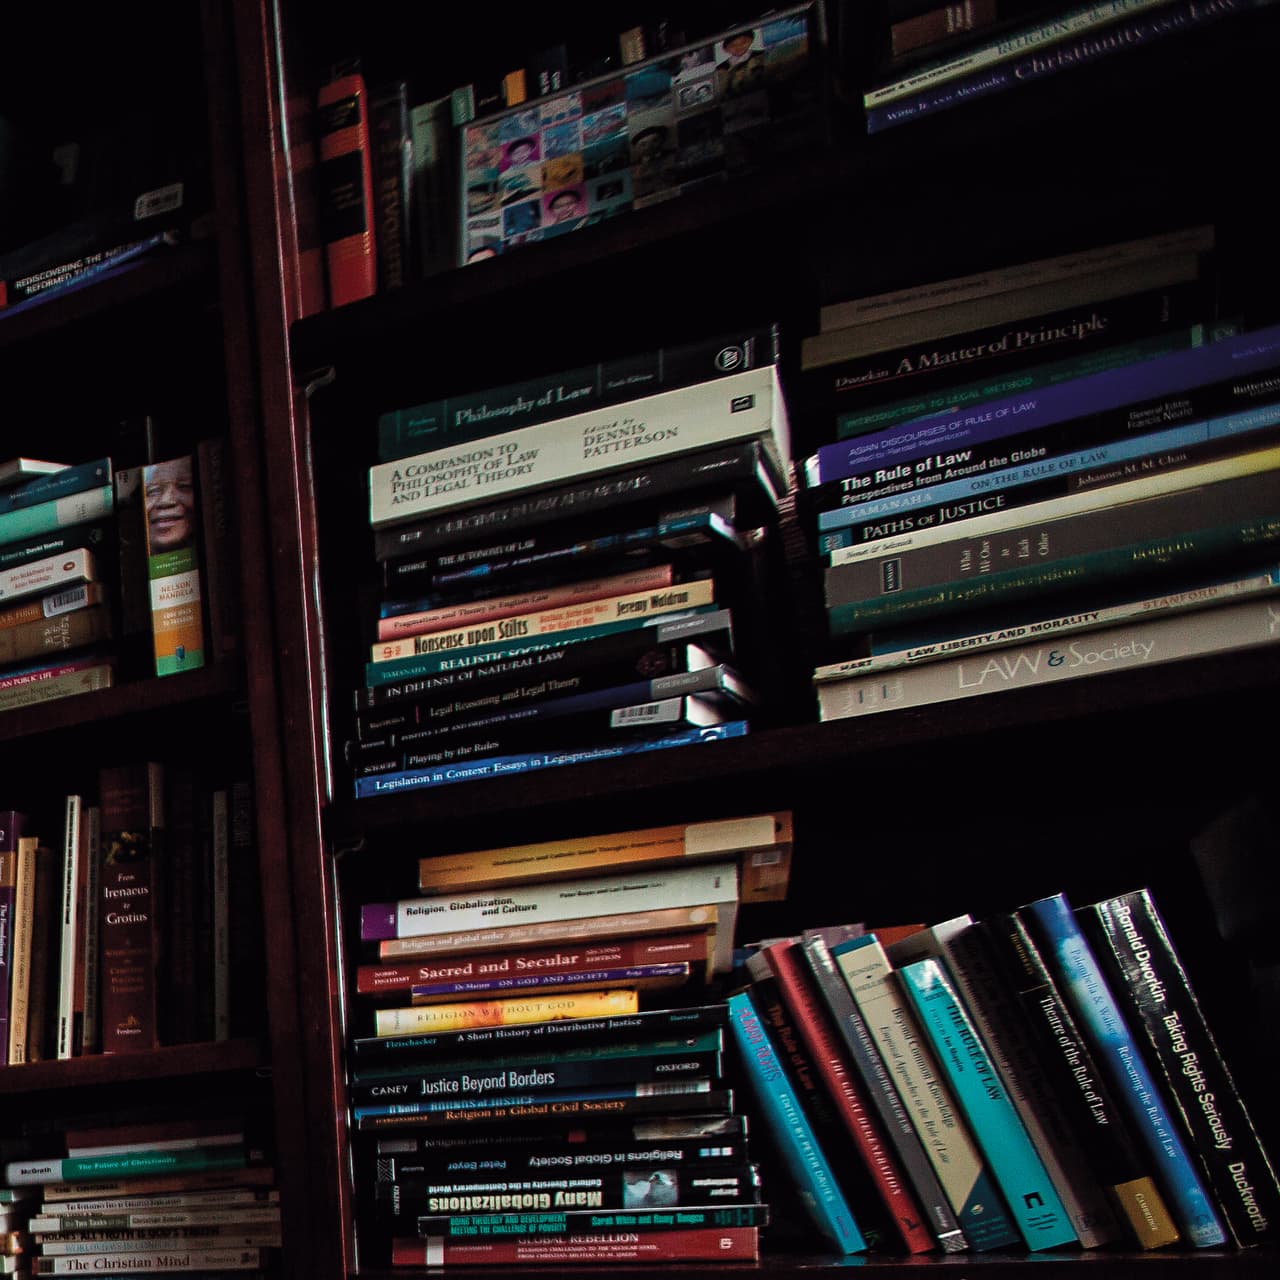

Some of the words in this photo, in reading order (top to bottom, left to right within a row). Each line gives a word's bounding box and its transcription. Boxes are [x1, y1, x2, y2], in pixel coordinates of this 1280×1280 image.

[896, 358, 913, 375] A
[918, 345, 986, 371] Matter
[989, 333, 1012, 353] of
[1016, 314, 1109, 348] Principle
[455, 396, 533, 426] Philosophy
[534, 391, 552, 408] of
[555, 384, 592, 401] Law
[583, 424, 645, 446] DENNIS
[583, 427, 679, 458] PATTERSON
[392, 469, 402, 481] A
[405, 449, 493, 478] COMPANION
[497, 442, 518, 457] TO
[392, 463, 480, 493] PHILOSOPHY
[484, 457, 503, 470] OF
[506, 449, 539, 465] LAW
[841, 472, 870, 491] The
[873, 463, 911, 485] Rule
[915, 458, 933, 475] of
[936, 449, 973, 469] Law
[392, 490, 421, 504] AND
[424, 478, 472, 498] LEGAL
[473, 463, 534, 487] THEORY
[842, 479, 912, 505] Perspectives
[915, 471, 946, 487] from
[948, 462, 986, 480] Around
[989, 456, 1006, 469] the
[1010, 446, 1046, 464] Globe
[864, 519, 914, 539] PATHS
[919, 513, 936, 527] OF
[938, 494, 1006, 525] JUSTICE
[159, 588, 194, 601] MANDELA
[161, 581, 191, 592] NELSON
[414, 629, 464, 654] Nonsense
[468, 626, 495, 645] upon
[499, 618, 527, 638] Stilts
[617, 597, 647, 617] Jeremy
[651, 591, 688, 609] Waldron
[839, 659, 873, 671] HART
[998, 628, 1025, 641] AND
[1031, 613, 1099, 633] MORALITY
[1143, 589, 1217, 610] STANFORD
[960, 650, 1043, 689] LAW
[1048, 650, 1064, 667] &
[1069, 641, 1155, 668] Society
[376, 770, 430, 790] Legislation
[433, 773, 443, 782] in
[446, 767, 491, 779] Context:
[494, 758, 527, 773] Essays
[531, 758, 541, 767] in
[543, 745, 624, 767] Legisprudence
[118, 873, 135, 881] From
[104, 886, 149, 898] Irenaeus
[450, 897, 515, 911] Globalization,
[107, 912, 148, 924] Grotius
[482, 907, 498, 916] and
[502, 903, 537, 914] Culture
[419, 965, 472, 980] Sacred
[480, 962, 509, 973] and
[516, 954, 578, 970] Secular
[417, 1011, 475, 1021] RELIGION
[481, 1004, 541, 1016] WITHOUT
[548, 1000, 575, 1010] GOD
[1040, 996, 1065, 1038] Theatre
[458, 1034, 465, 1042] A
[467, 1031, 494, 1041] Short
[497, 1028, 530, 1041] History
[547, 1023, 606, 1034] Distributive
[608, 1018, 642, 1028] Justice
[1057, 1035, 1070, 1050] of
[1062, 1047, 1078, 1067] the
[1115, 906, 1141, 952] Ronald
[1135, 949, 1166, 1003] Dworkin
[1162, 1010, 1189, 1054] Taking
[1179, 1051, 1207, 1093] Rights
[1199, 1092, 1233, 1151] Seriously
[1228, 1161, 1268, 1232] Duckworth
[371, 1086, 408, 1097] CANEY
[421, 1077, 460, 1095] Justice
[463, 1074, 506, 1092] Beyond
[509, 1070, 555, 1089] Borders
[1072, 1066, 1092, 1096] Rule
[446, 1109, 492, 1120] Religion
[495, 1108, 506, 1117] in
[510, 1105, 547, 1117] Global
[552, 1102, 578, 1113] Civil
[581, 1100, 626, 1112] Society
[1084, 1093, 1098, 1108] of
[1092, 1105, 1109, 1127] Law
[429, 1193, 551, 1211] Globalizations
[555, 1193, 602, 1210] Many
[66, 1260, 90, 1270] The
[94, 1258, 153, 1269] Christian
[156, 1256, 190, 1267] Mind
